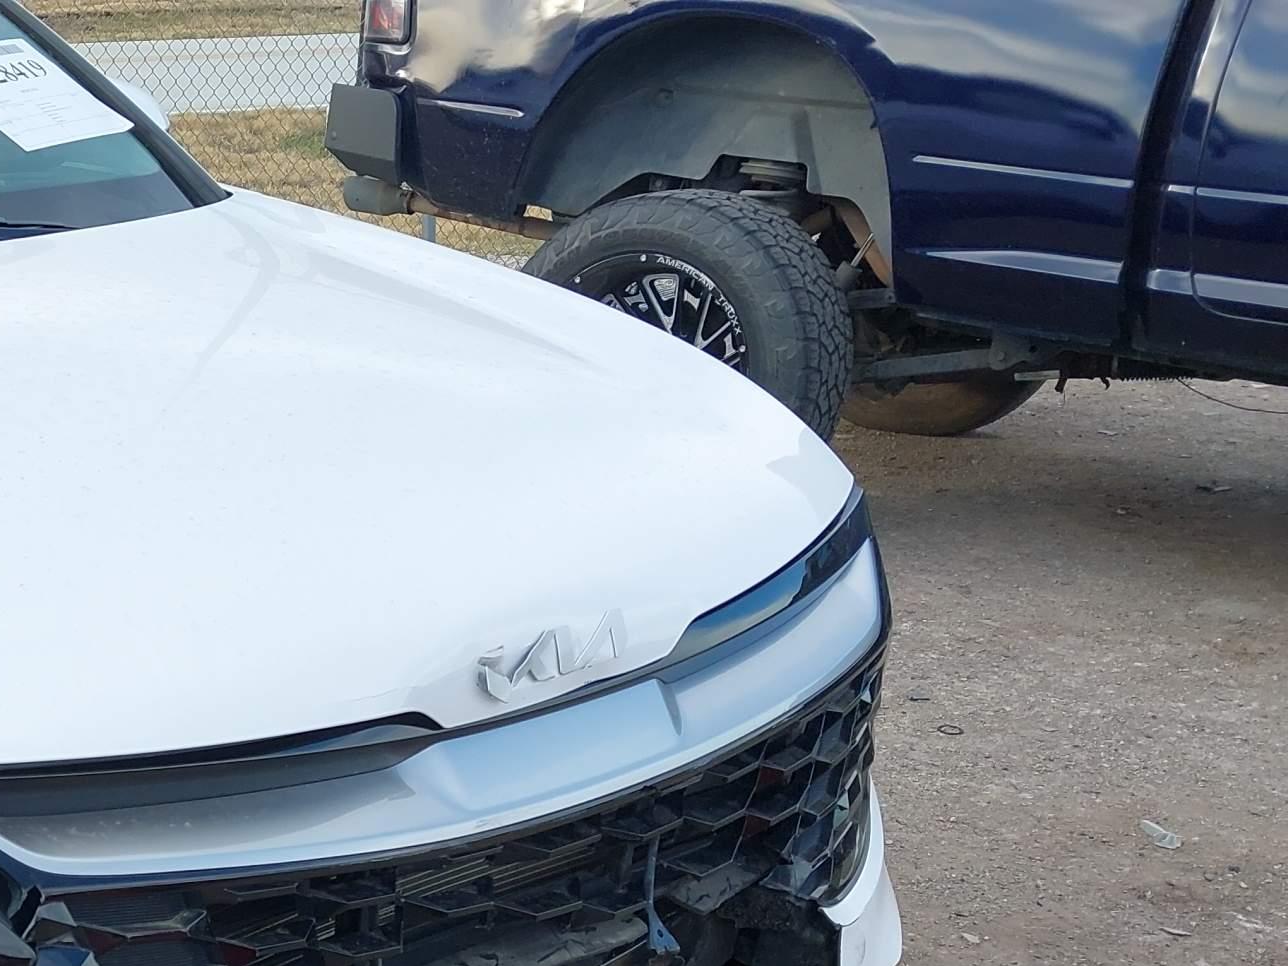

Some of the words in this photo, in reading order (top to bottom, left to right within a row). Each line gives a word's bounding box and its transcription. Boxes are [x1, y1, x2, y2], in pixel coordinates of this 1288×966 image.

[656, 255, 715, 291] AMERICAN
[714, 293, 743, 336] TRUXX
[476, 608, 628, 704] KIA
